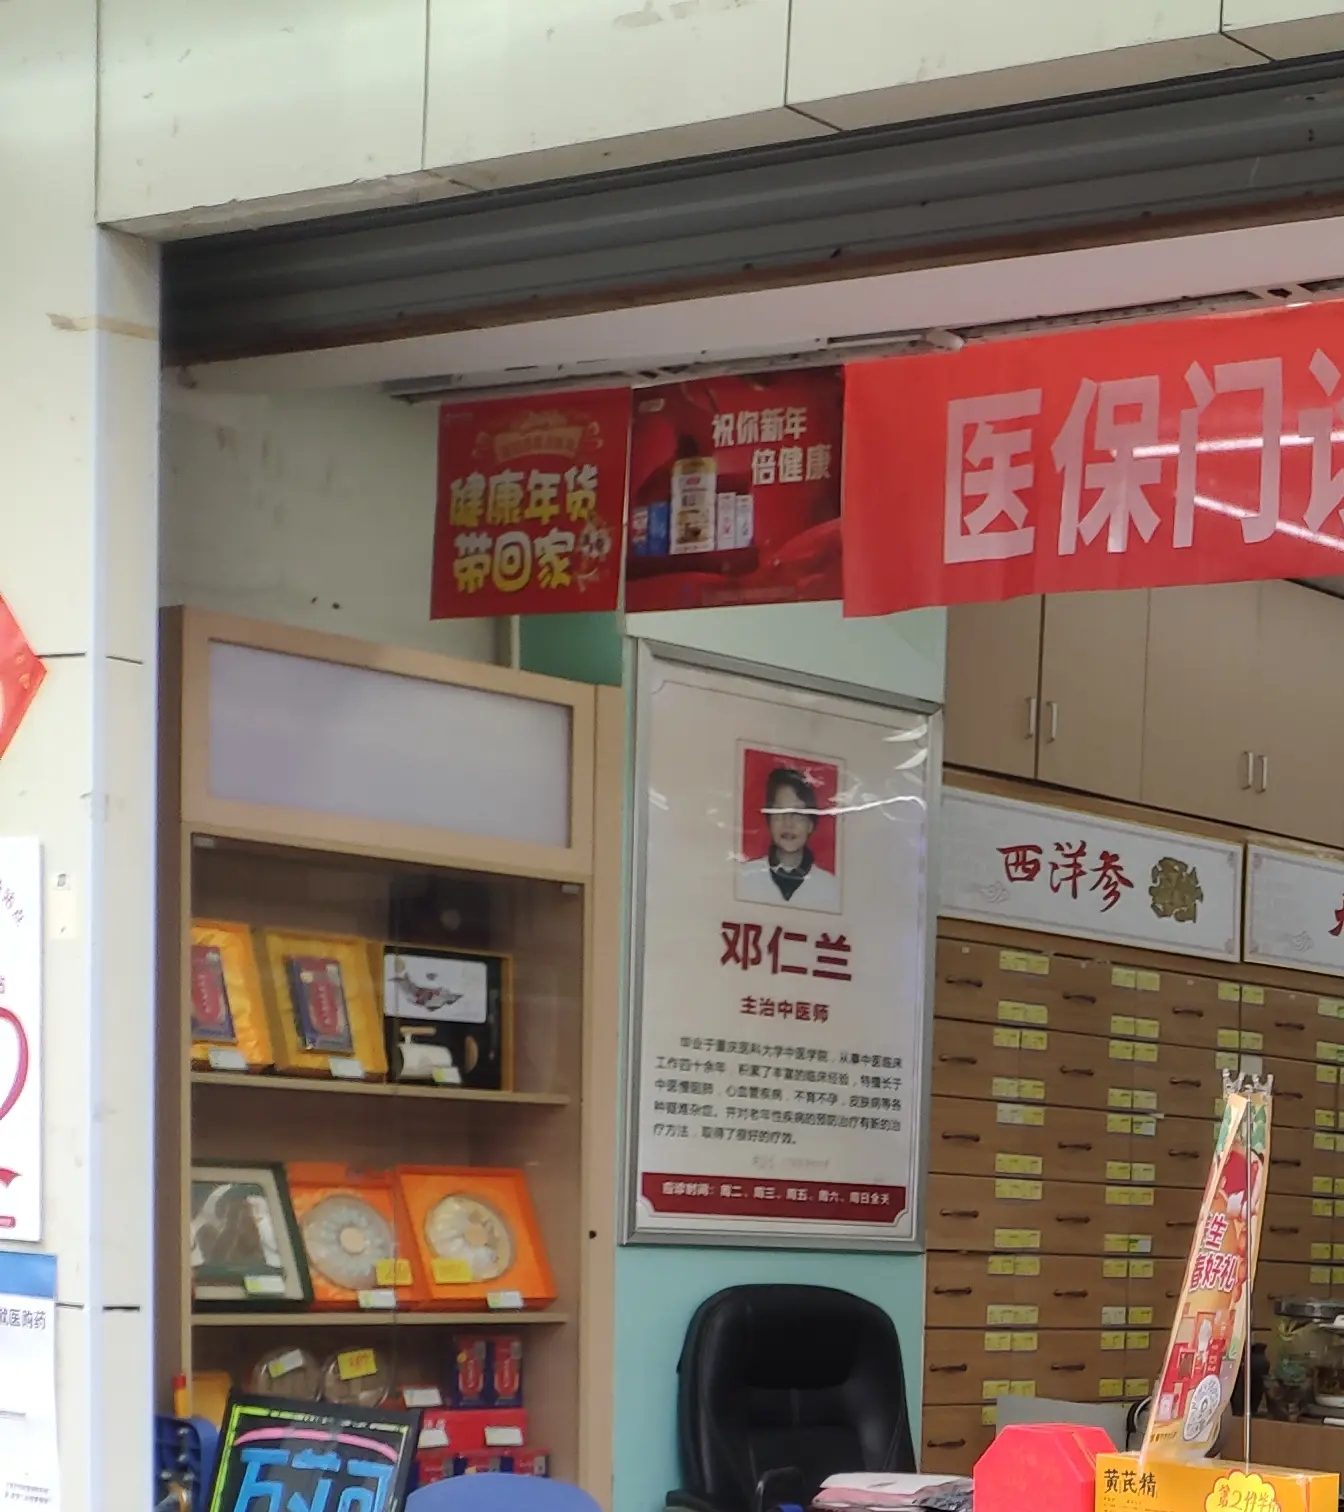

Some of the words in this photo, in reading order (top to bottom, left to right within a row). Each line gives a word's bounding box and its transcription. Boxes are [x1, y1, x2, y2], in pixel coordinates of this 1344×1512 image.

[711, 406, 808, 447] 祝你新年
[751, 444, 833, 486] 倍健康
[449, 463, 599, 529] 健康年货
[454, 527, 577, 594] 带回家
[996, 840, 1134, 913] 西洋参
[720, 920, 853, 982] 邓仁兰
[740, 996, 830, 1024] 主治中医师
[1103, 1468, 1157, 1499] 黄芪精
